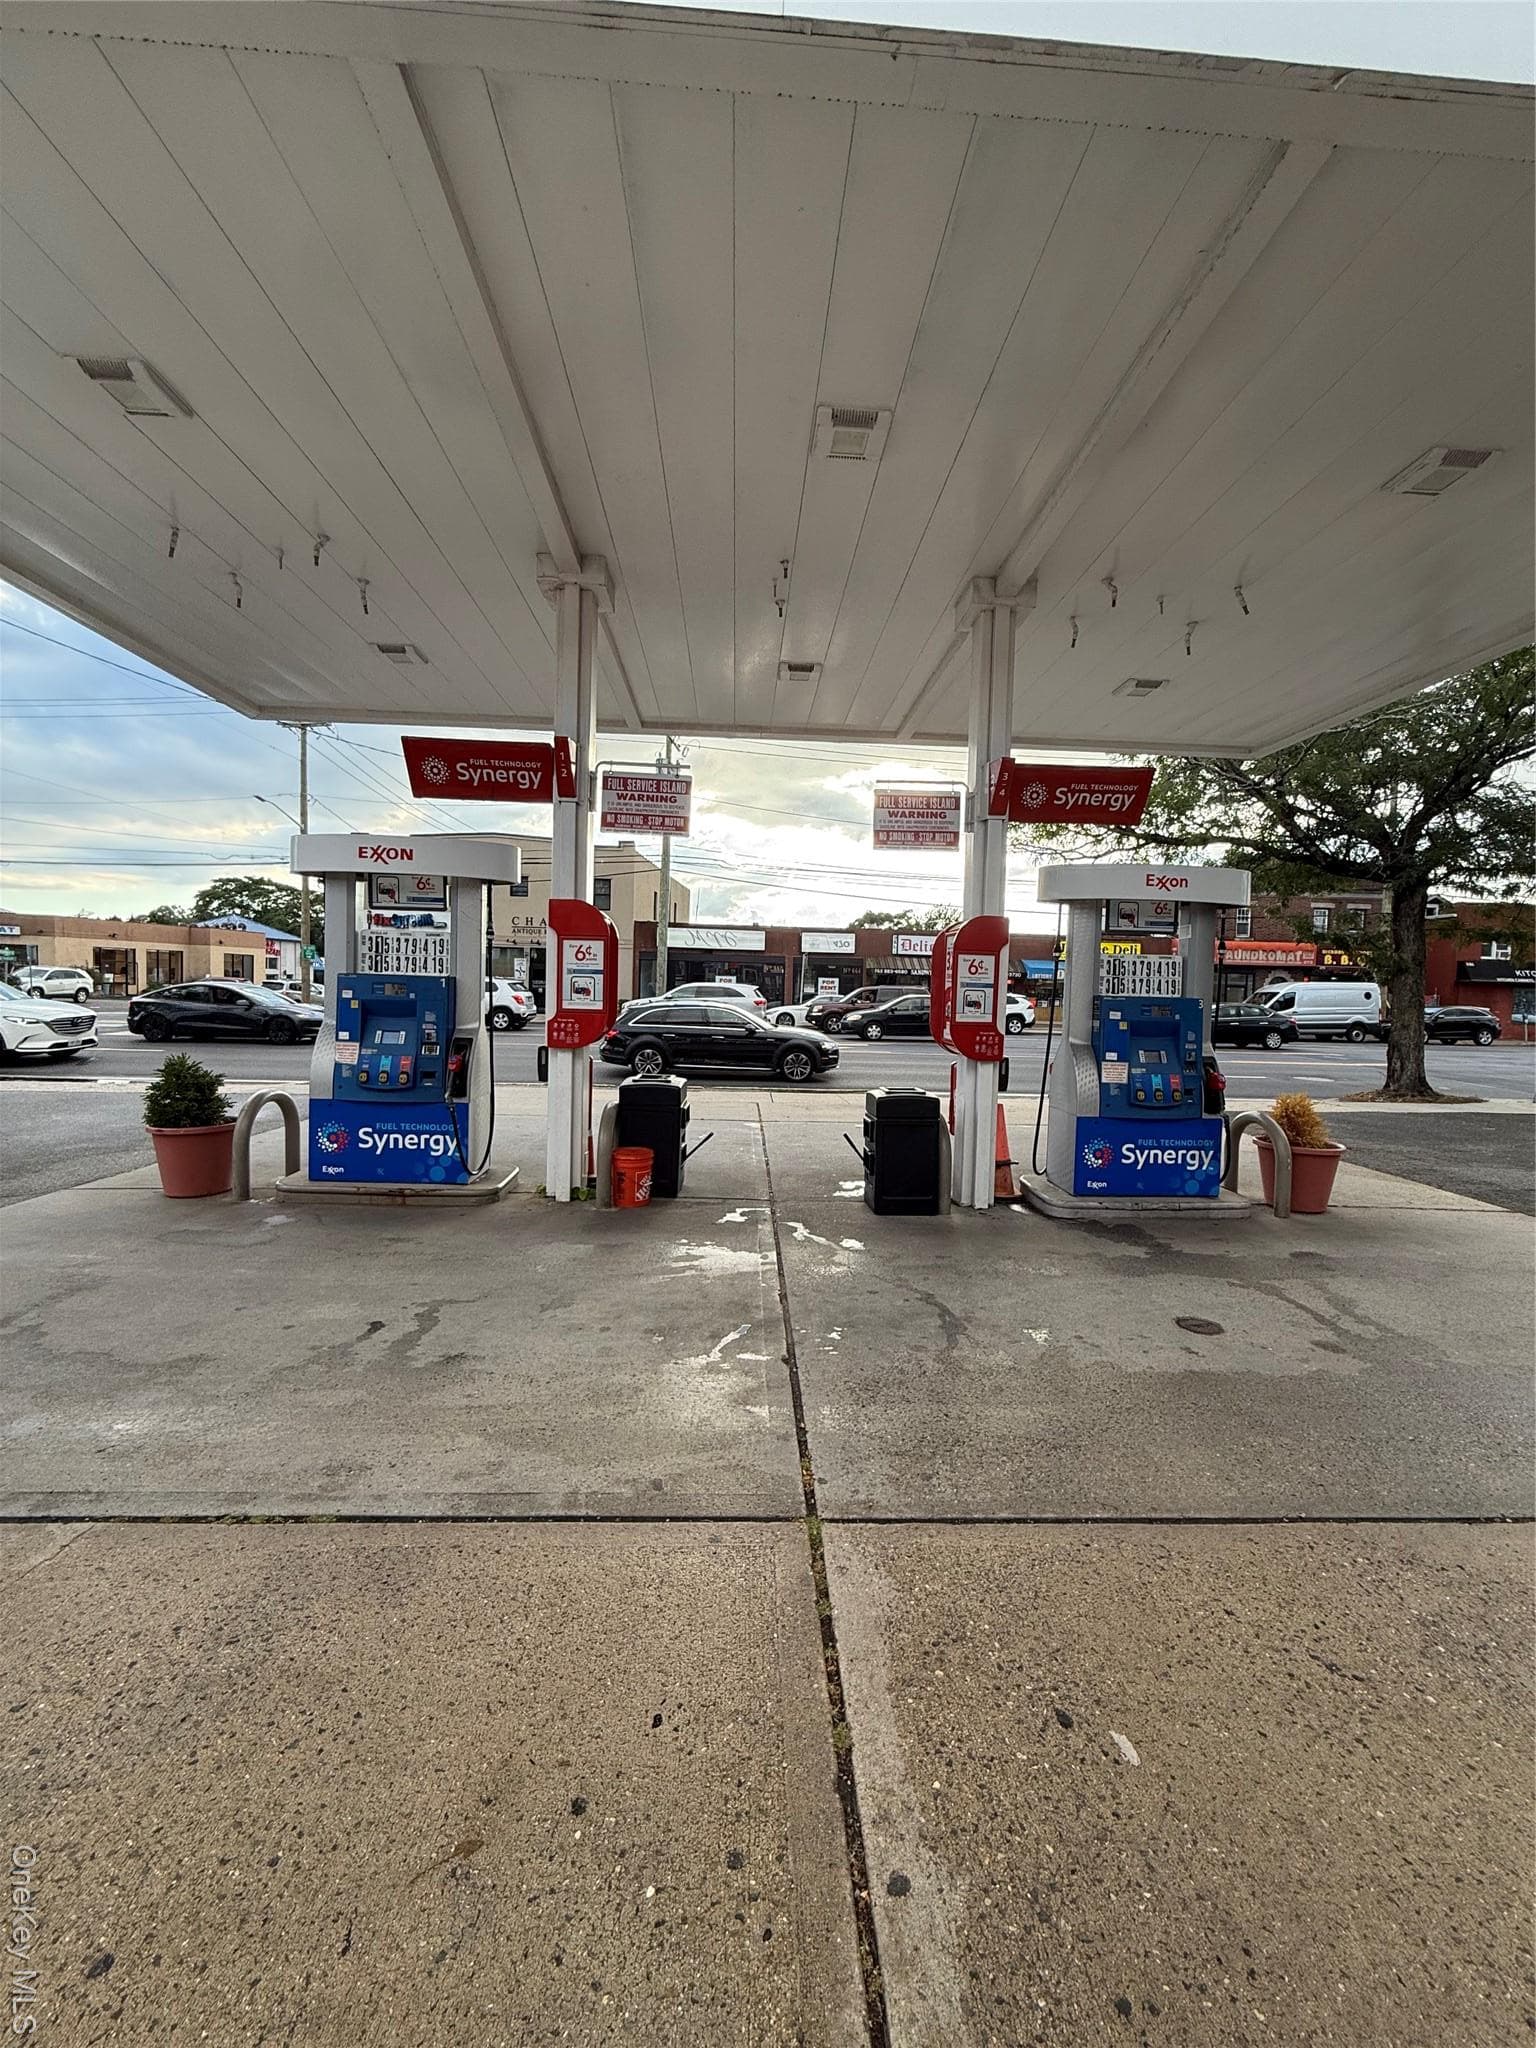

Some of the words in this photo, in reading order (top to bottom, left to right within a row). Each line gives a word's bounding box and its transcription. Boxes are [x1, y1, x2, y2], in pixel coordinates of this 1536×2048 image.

[560, 752, 564, 760] 1
[490, 760, 542, 768] TECHNOLOGY
[456, 762, 542, 789] Synergy
[562, 768, 568, 777] 2
[1002, 772, 1008, 780] 3
[608, 778, 624, 790] FULL
[627, 779, 657, 792] SERVICE
[660, 781, 686, 794] ISLAND
[616, 792, 678, 804] WARNING
[880, 796, 895, 808] FULL
[898, 797, 927, 808] SERVICE
[930, 798, 956, 809] ISLAND
[1054, 788, 1136, 812] Synergy
[607, 814, 615, 823] NO
[617, 815, 644, 825] SMOKING
[648, 816, 663, 826] STOP
[665, 817, 685, 827] MOTOR
[888, 810, 947, 819] WARNING
[880, 832, 887, 840] NO
[889, 832, 914, 841] SMOKING
[919, 832, 933, 841] STOP
[935, 833, 954, 842] MOTOR
[358, 844, 414, 864] EXXON
[1146, 874, 1188, 891] Exxon
[575, 944, 592, 961] 6¢
[1113, 944, 1138, 954] Deli
[1226, 950, 1303, 962] AUNDROMAT
[968, 959, 984, 975] 6¢
[440, 978, 446, 988] 1
[1198, 1000, 1204, 1009] 3
[358, 1128, 457, 1156] Synergy
[1121, 1144, 1214, 1170] Synergy
[322, 1166, 344, 1175] Exxon
[1087, 1181, 1107, 1189] Exxon
